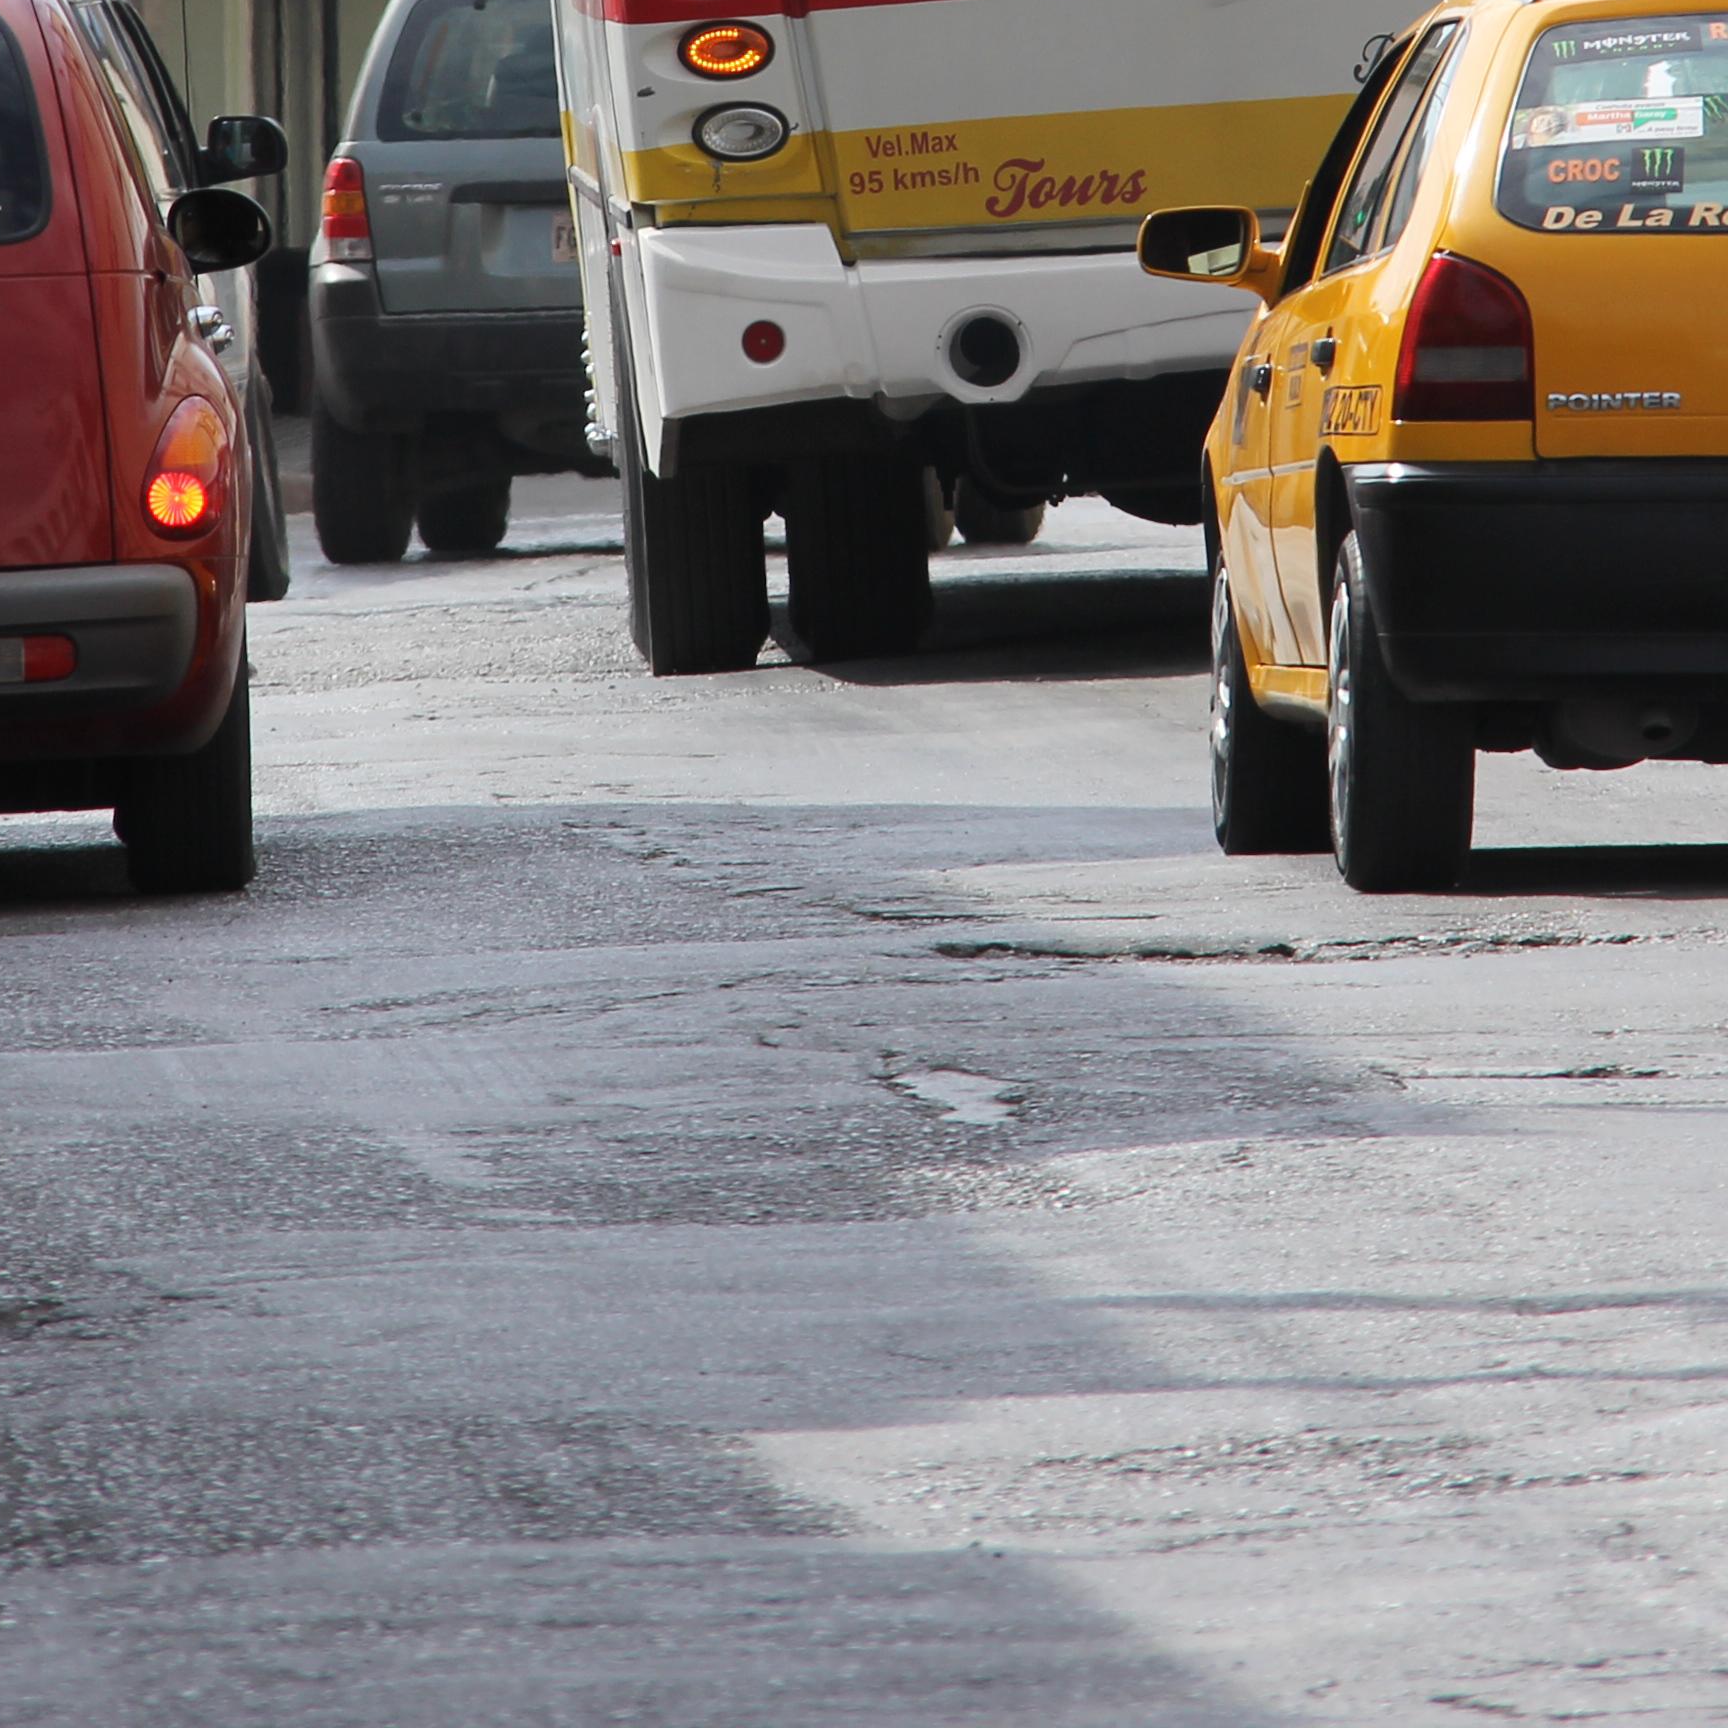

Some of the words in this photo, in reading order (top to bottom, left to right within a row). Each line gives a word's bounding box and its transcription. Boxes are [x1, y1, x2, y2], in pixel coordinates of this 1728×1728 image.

[865, 131, 958, 159] Vel.Max
[848, 170, 884, 196] 95
[892, 161, 981, 192] kms/h
[1547, 157, 1621, 184] CROC
[985, 158, 1148, 219] Tours
[1541, 205, 1603, 230] De
[1617, 203, 1674, 228] La
[1547, 391, 1682, 411] POINTER
